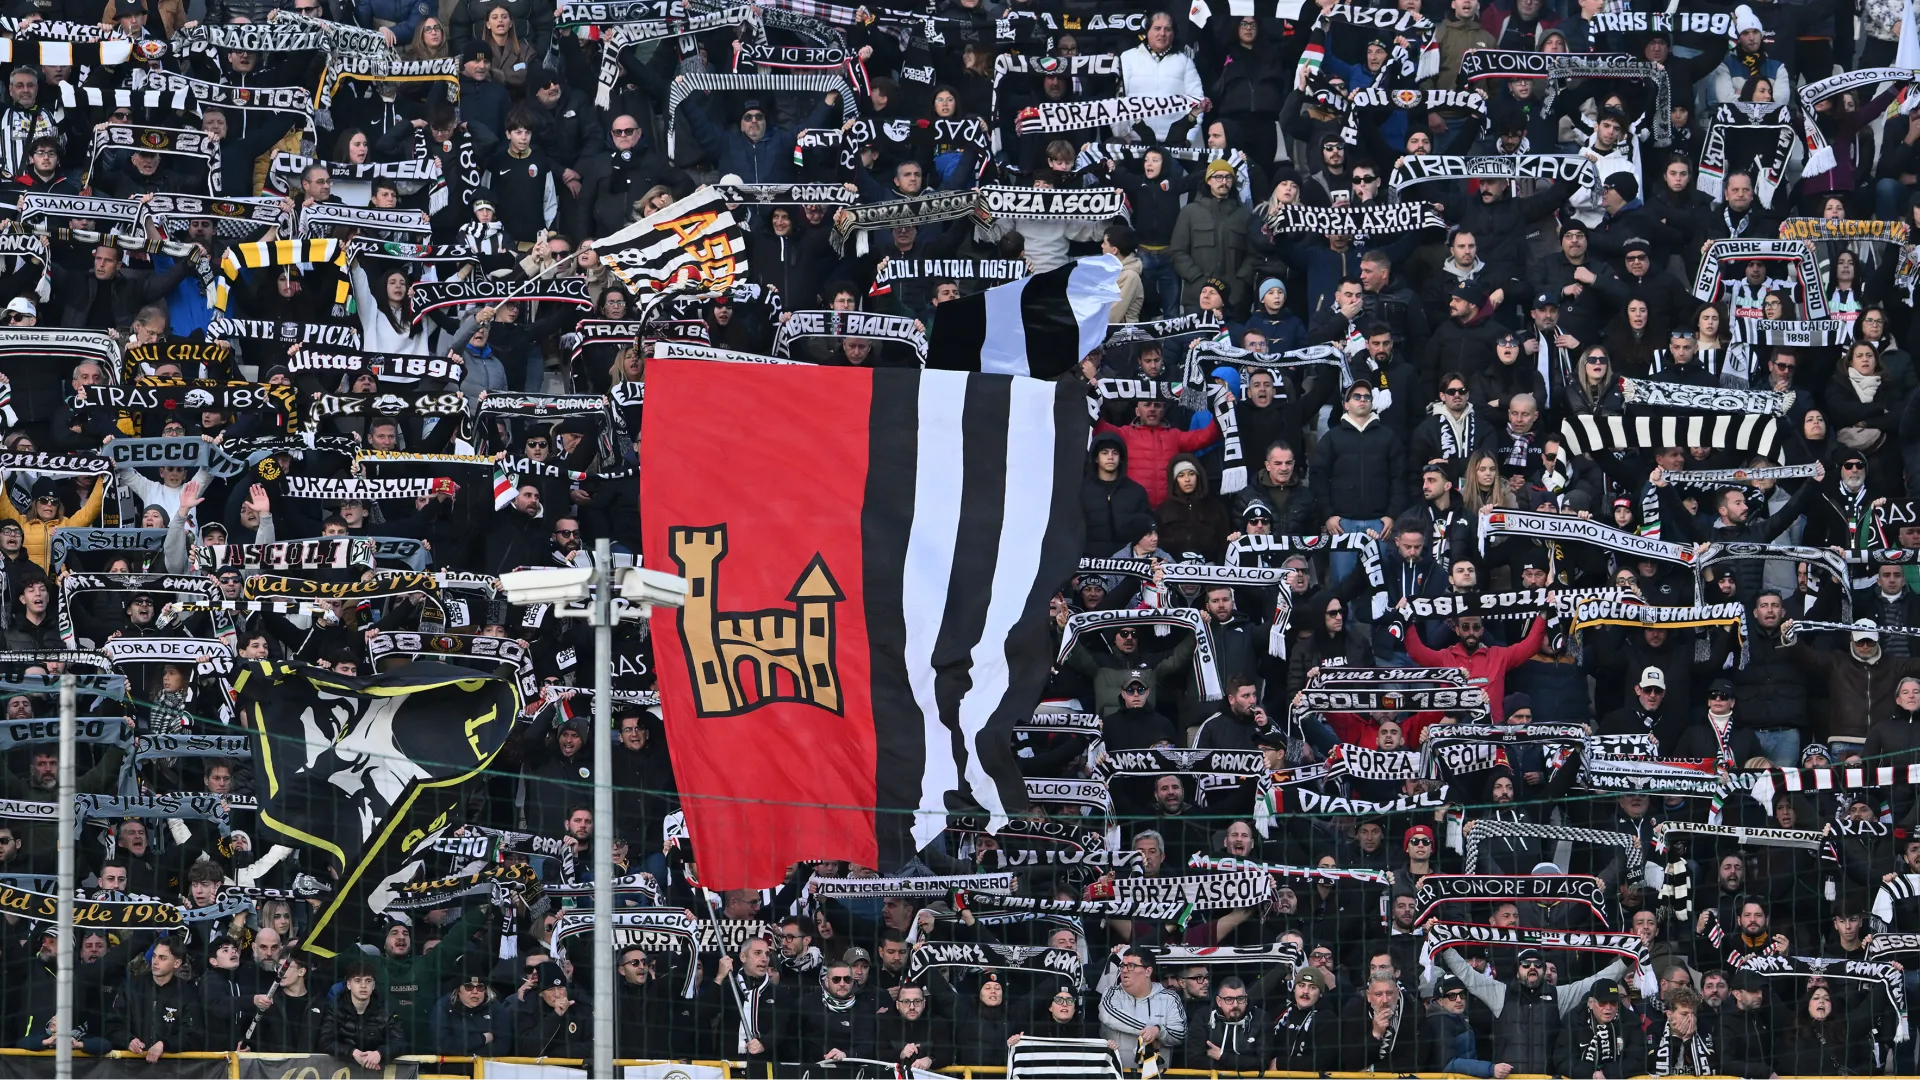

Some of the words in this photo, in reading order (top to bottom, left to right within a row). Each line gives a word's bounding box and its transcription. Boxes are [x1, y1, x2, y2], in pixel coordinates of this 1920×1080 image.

[210, 31, 321, 50] RAGAZZI
[1488, 54, 1551, 71] L'ONOR
[1043, 103, 1111, 127] FORZA
[36, 198, 85, 212] SIAMO
[90, 202, 105, 213] LA
[1050, 194, 1121, 214] ASCOLI
[357, 211, 412, 224] CALCIO
[856, 204, 914, 223] FORZA
[1827, 219, 1884, 237] SIGNO
[924, 260, 974, 278] PATRIA
[435, 281, 516, 299] L'ONORE
[524, 280, 541, 295] DI
[1736, 308, 1763, 318] Confora
[1785, 332, 1810, 344] 1898
[1649, 391, 1774, 414] ASCOLI
[113, 441, 200, 462] CECCO
[1518, 516, 1546, 531] NOI
[1549, 522, 1598, 537] SIAMO
[1601, 530, 1618, 545] LA
[1620, 537, 1669, 554] STORIA
[222, 539, 343, 565] ASCOLI
[1216, 567, 1275, 580] CALCIO
[1068, 609, 1130, 632] ASCOLI
[1137, 608, 1200, 623] CALCIO
[114, 644, 155, 655] L'ORA
[161, 644, 181, 655] DE
[1379, 668, 1424, 682] Sud
[1349, 752, 1411, 773] FORZA
[1075, 784, 1107, 800] 1898
[1006, 819, 1079, 838] L'ONO
[915, 876, 1009, 891] BIANCONERO
[1441, 879, 1525, 895] L'ONORE
[1533, 880, 1550, 894] DI
[38, 898, 113, 925] Syle
[1104, 902, 1131, 915] SA
[561, 914, 623, 928] ASCLI
[630, 914, 692, 928] CALCIO
[1427, 924, 1518, 950] ASCOLI
